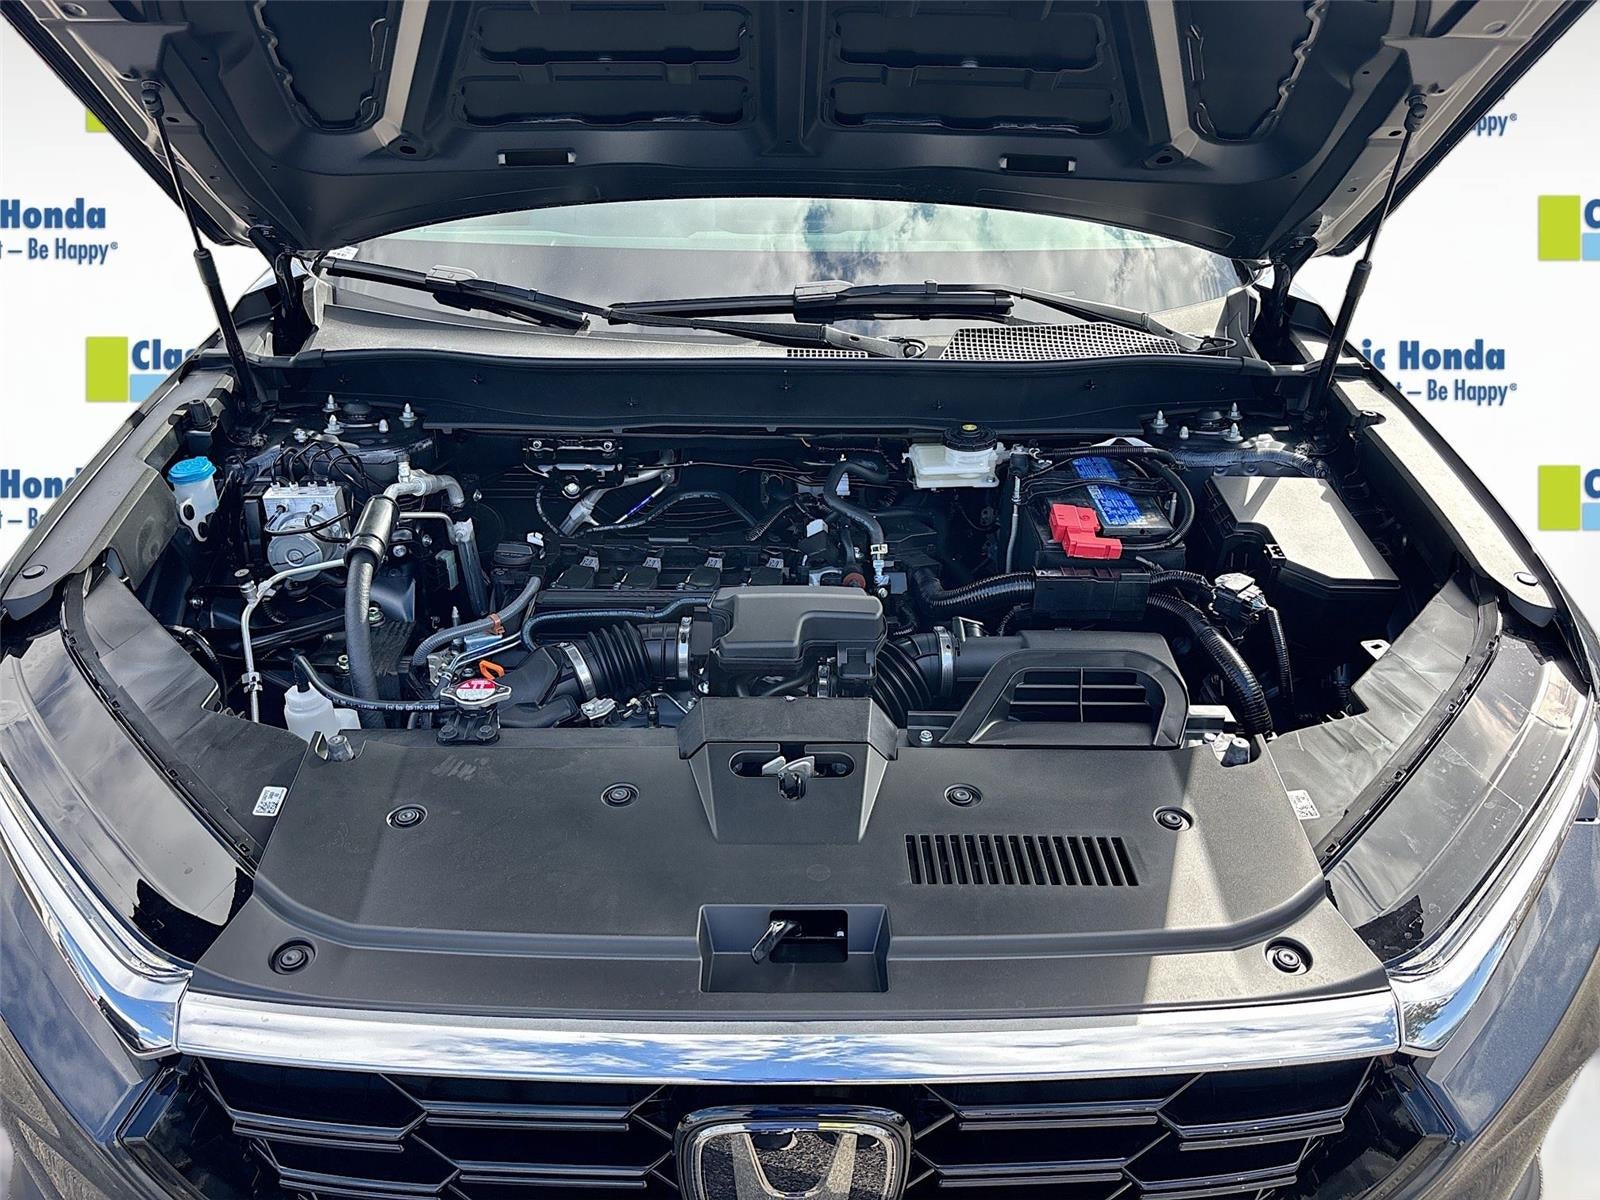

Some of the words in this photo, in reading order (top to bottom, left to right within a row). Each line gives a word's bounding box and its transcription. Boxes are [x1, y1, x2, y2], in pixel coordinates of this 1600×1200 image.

[0, 197, 106, 229] Honda
[28, 237, 48, 260] Be
[1399, 339, 1505, 370] Honda
[1427, 379, 1448, 401] Be
